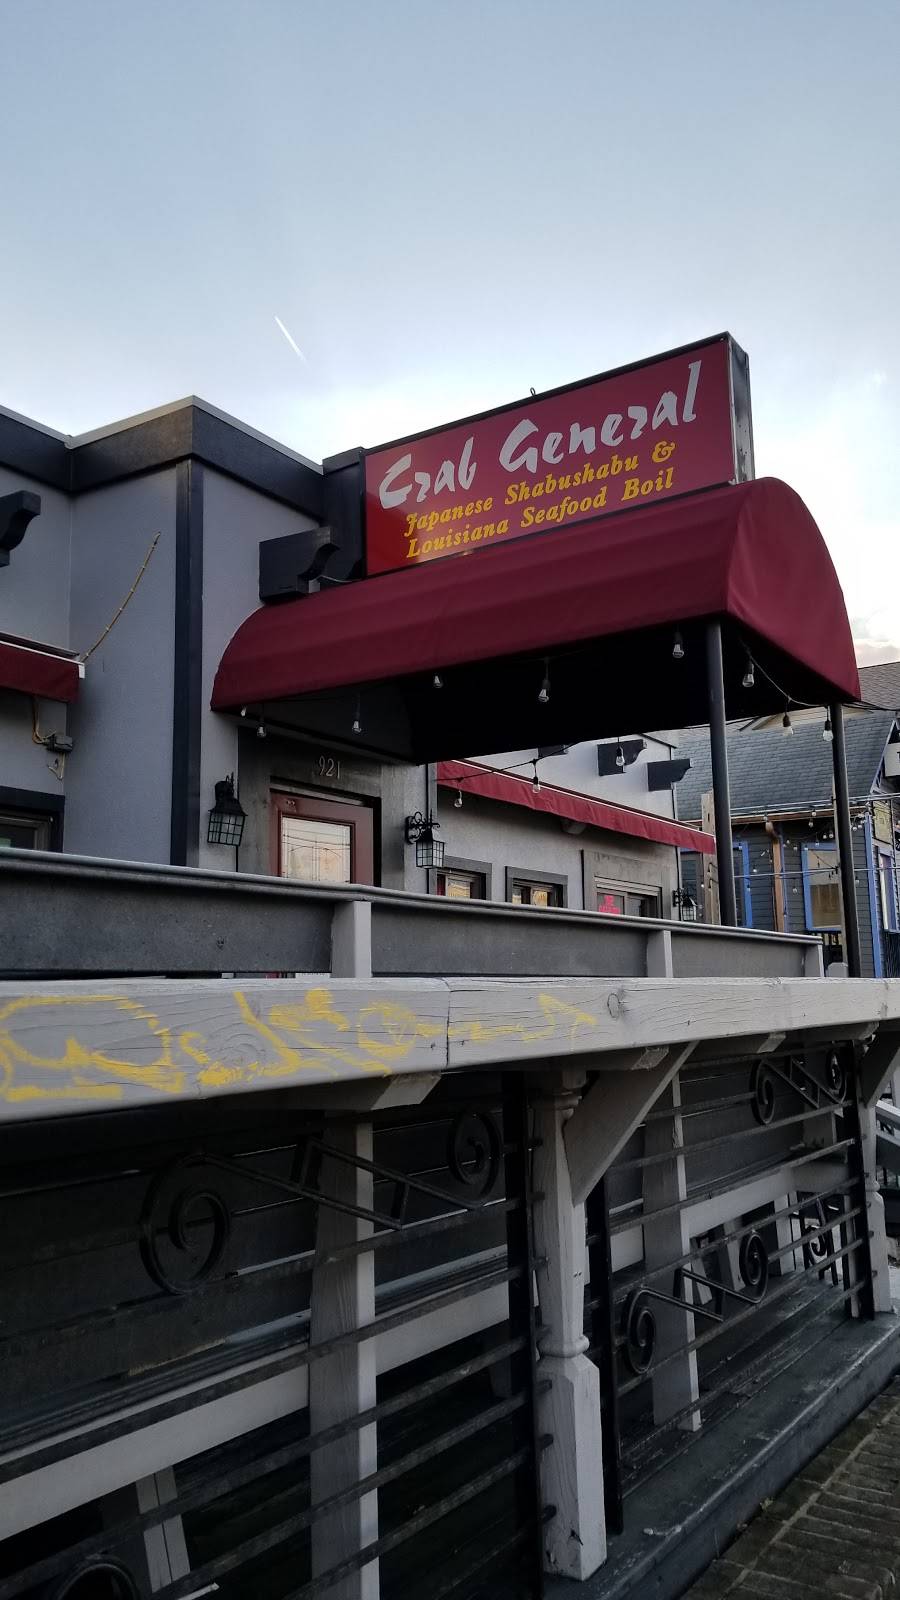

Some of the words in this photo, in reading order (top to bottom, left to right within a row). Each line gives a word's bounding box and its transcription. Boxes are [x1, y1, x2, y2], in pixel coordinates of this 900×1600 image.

[379, 437, 477, 509] Crab
[499, 361, 701, 474] General
[404, 497, 493, 537] Japanese
[504, 455, 638, 505] Shabushabu
[651, 441, 676, 463] &
[406, 520, 508, 558] Louisiana
[520, 486, 607, 528] Seafood
[621, 467, 673, 501] Boil
[318, 755, 341, 780] 921
